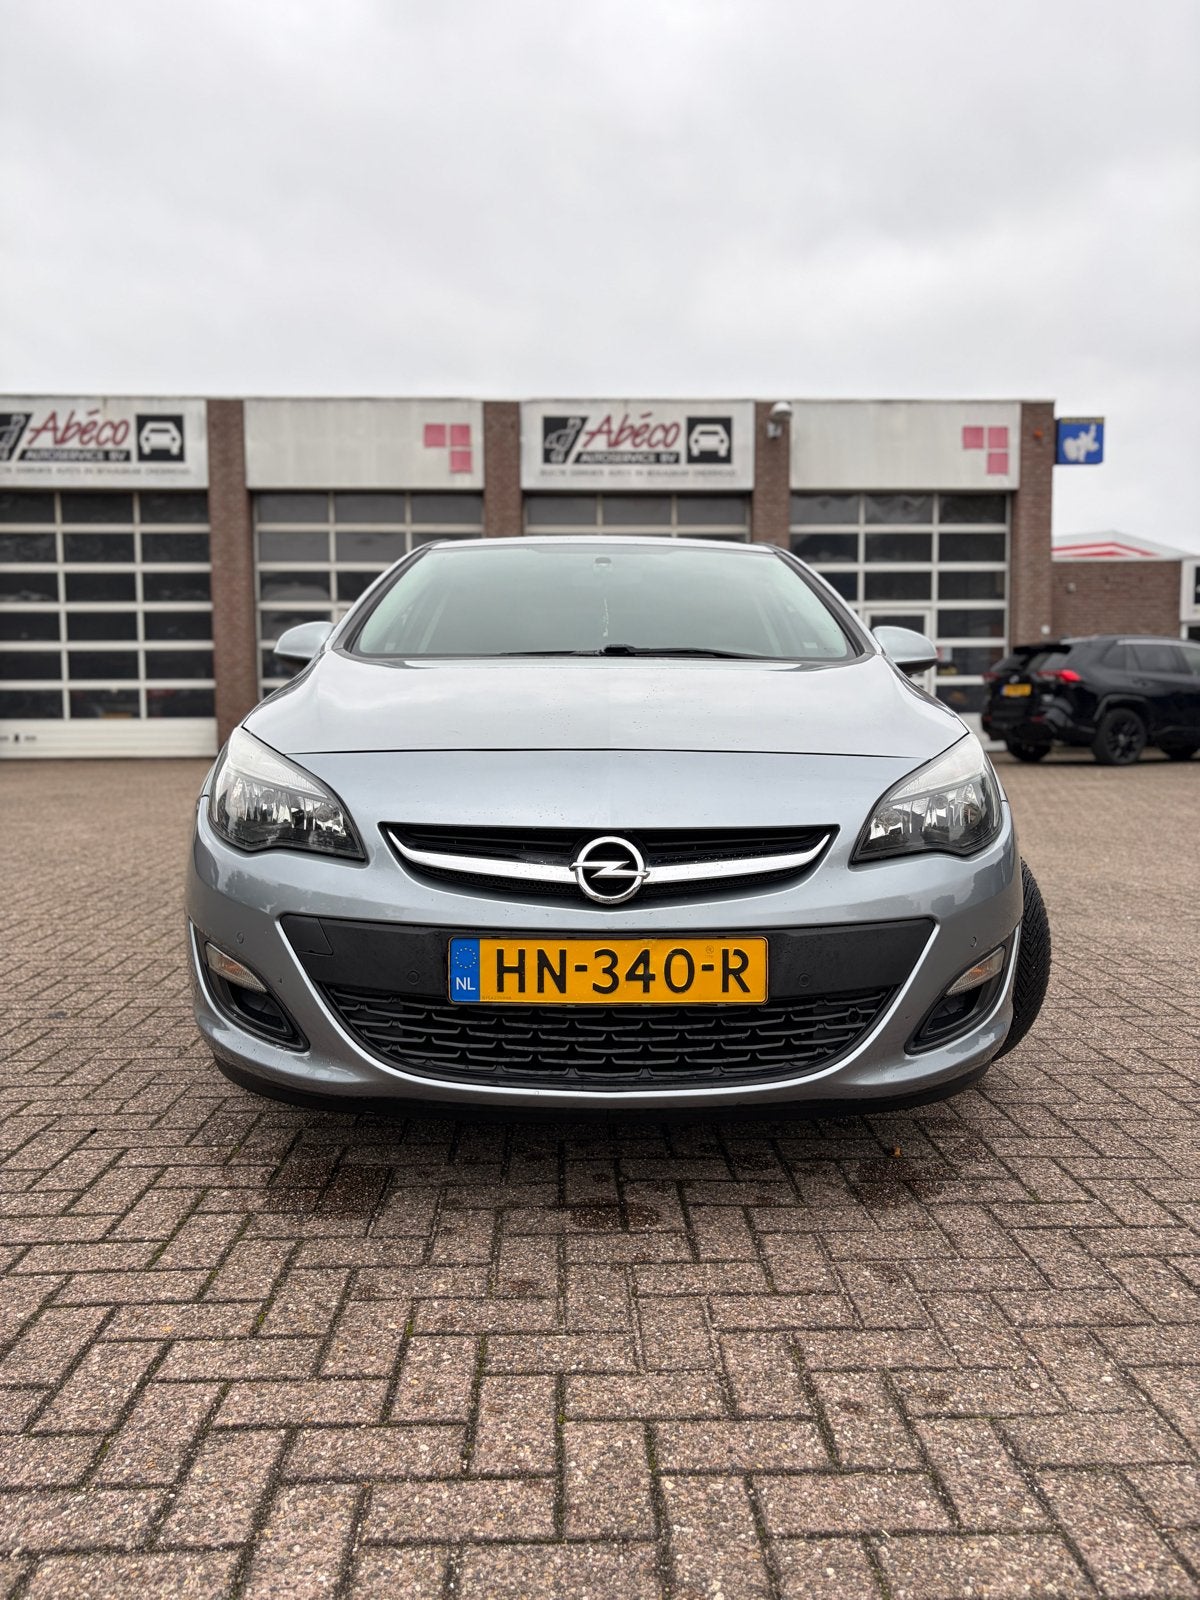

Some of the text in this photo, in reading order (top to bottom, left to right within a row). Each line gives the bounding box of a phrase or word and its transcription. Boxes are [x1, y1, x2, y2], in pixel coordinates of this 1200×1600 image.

[27, 409, 130, 446] Abéco
[583, 411, 680, 448] Abéco
[24, 450, 103, 462] AUTOSERVICE
[455, 977, 476, 991] NL
[495, 948, 751, 994] HN-340-R
